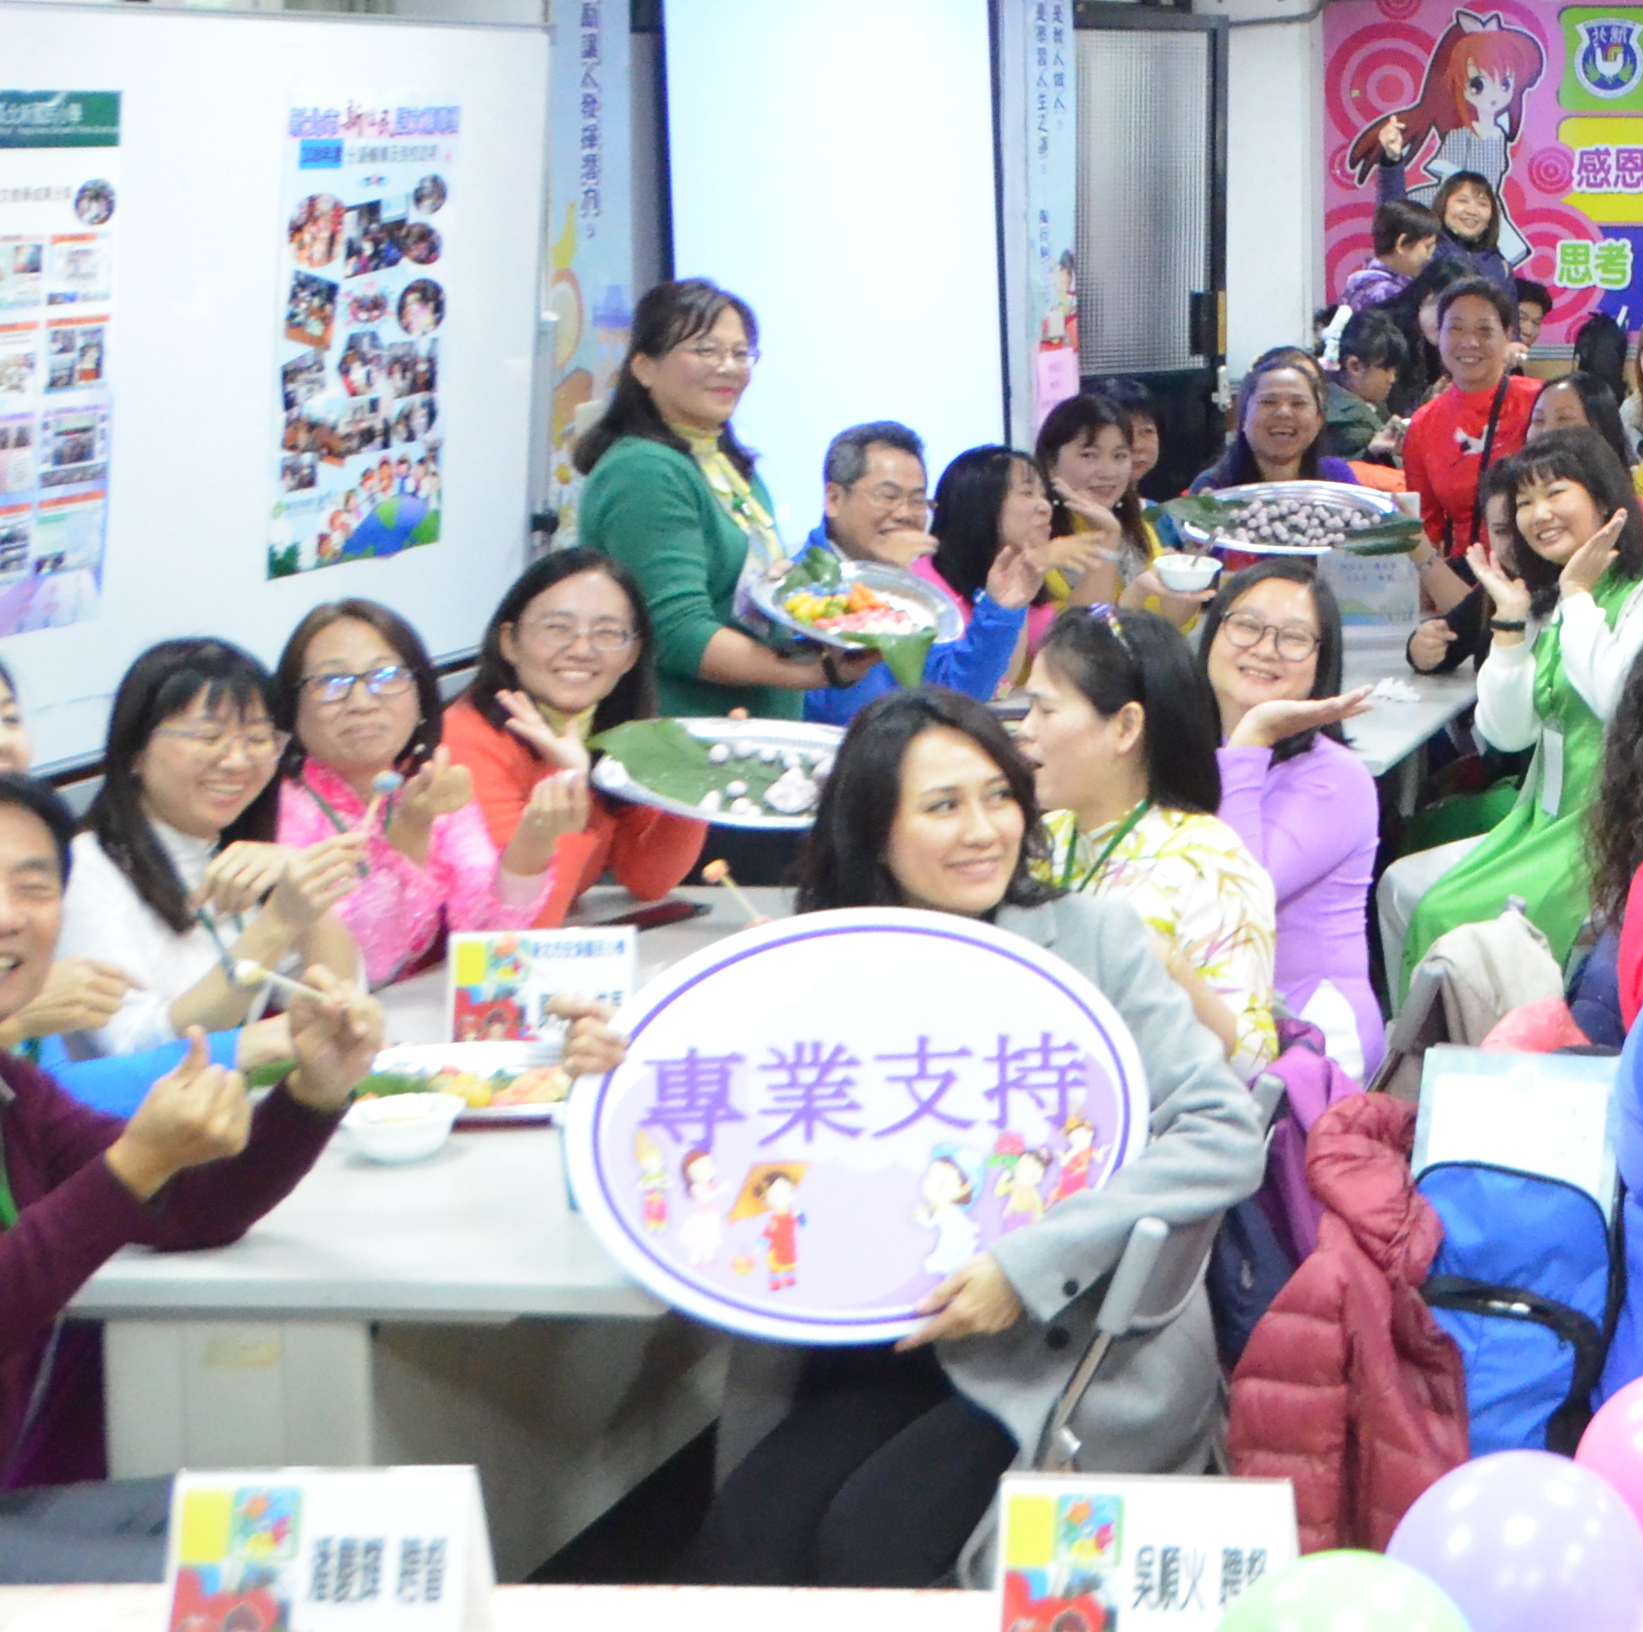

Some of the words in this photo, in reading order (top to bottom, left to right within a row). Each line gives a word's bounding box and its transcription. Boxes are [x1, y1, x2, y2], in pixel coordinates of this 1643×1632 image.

[1556, 241, 1630, 288] 思考
[639, 1032, 1090, 1150] 專業支持
